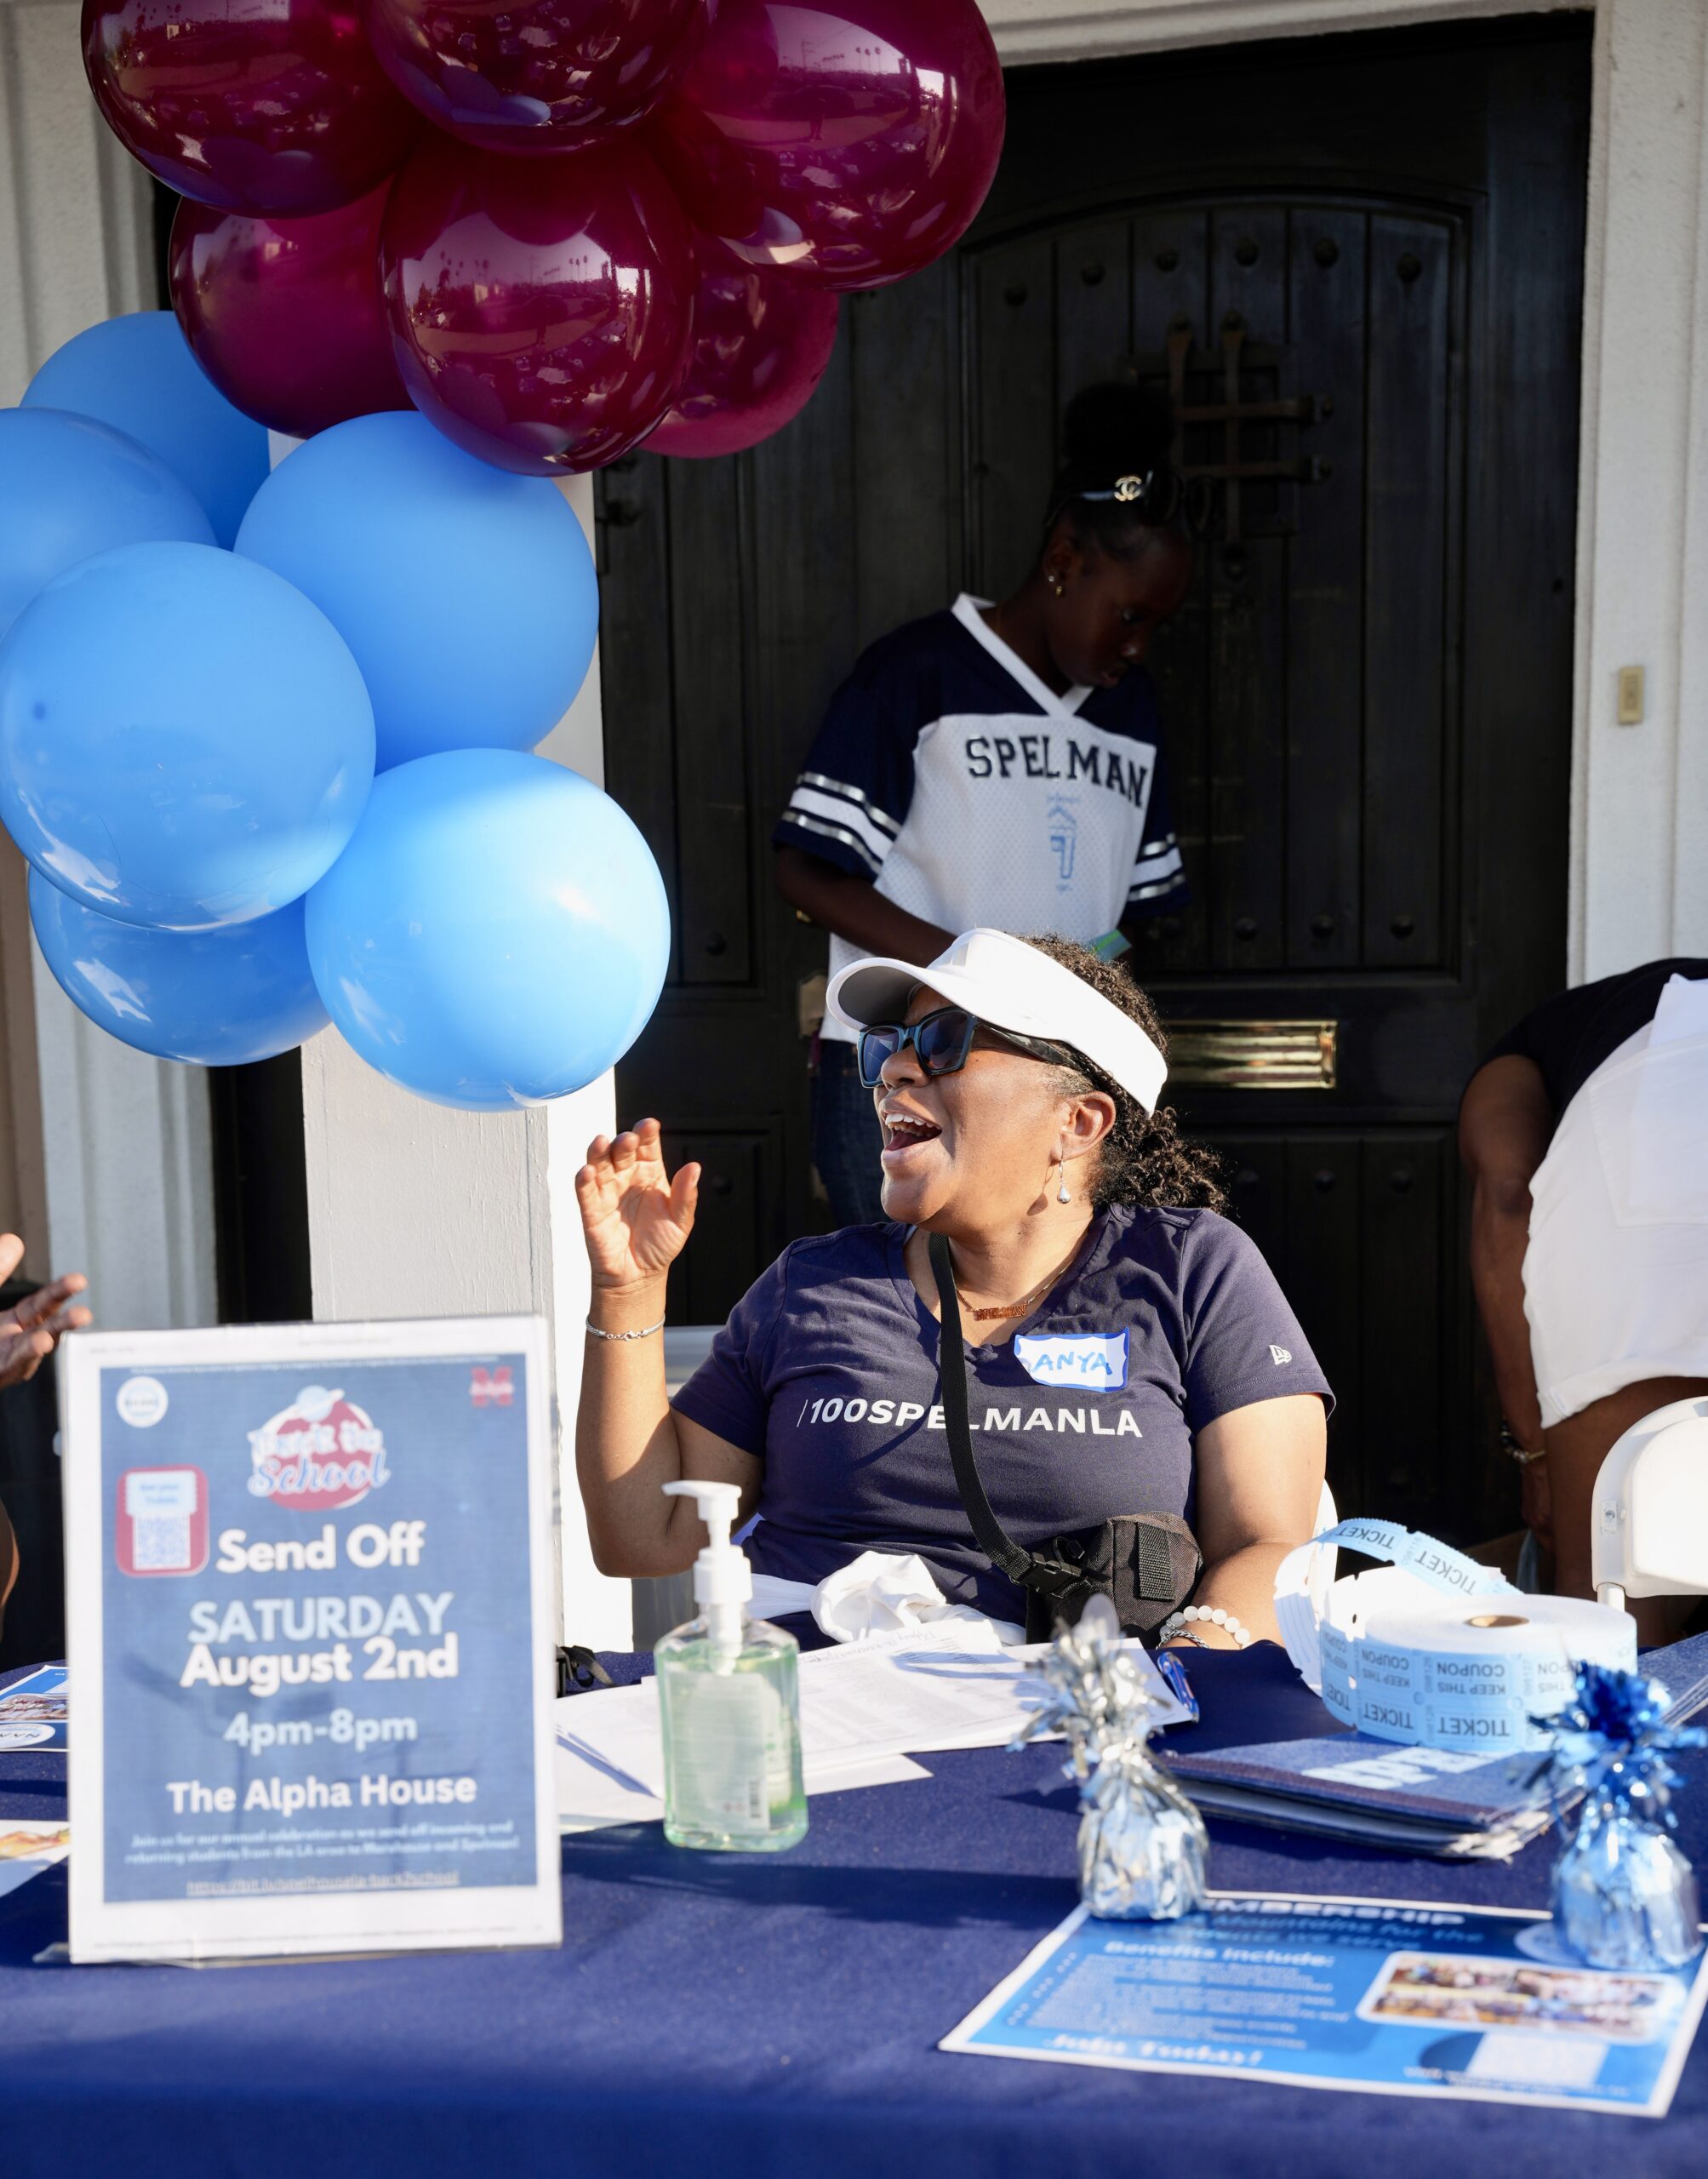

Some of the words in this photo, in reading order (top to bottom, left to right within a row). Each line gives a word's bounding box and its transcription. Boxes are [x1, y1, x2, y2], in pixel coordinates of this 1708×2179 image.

[966, 735, 1147, 808] SPELMAN
[247, 1449, 391, 1497] School
[215, 1523, 336, 1573] Send
[346, 1520, 426, 1568] Off
[1334, 1526, 1396, 1550] TICKET
[1414, 1550, 1477, 1596] TICKET
[188, 1592, 454, 1644] SATURDAY
[180, 1643, 352, 1698] August
[363, 1632, 458, 1681] 2nd
[1362, 1649, 1409, 1671] COUPON
[1437, 1662, 1505, 1678] COUPON
[1383, 1673, 1410, 1688] KEEP
[1437, 1682, 1466, 1695] THIS
[1470, 1684, 1505, 1696] KEEP
[1363, 1701, 1414, 1730] TICKET
[1437, 1717, 1511, 1736] TICKET
[223, 1707, 417, 1757] 4pm-8pm
[166, 1779, 237, 1814] The
[243, 1775, 352, 1818] Alpha
[360, 1774, 477, 1806] House
[1104, 1941, 1216, 1959] Benefits
[1052, 2033, 1127, 2056] Join
[1140, 2040, 1265, 2067] Today!
